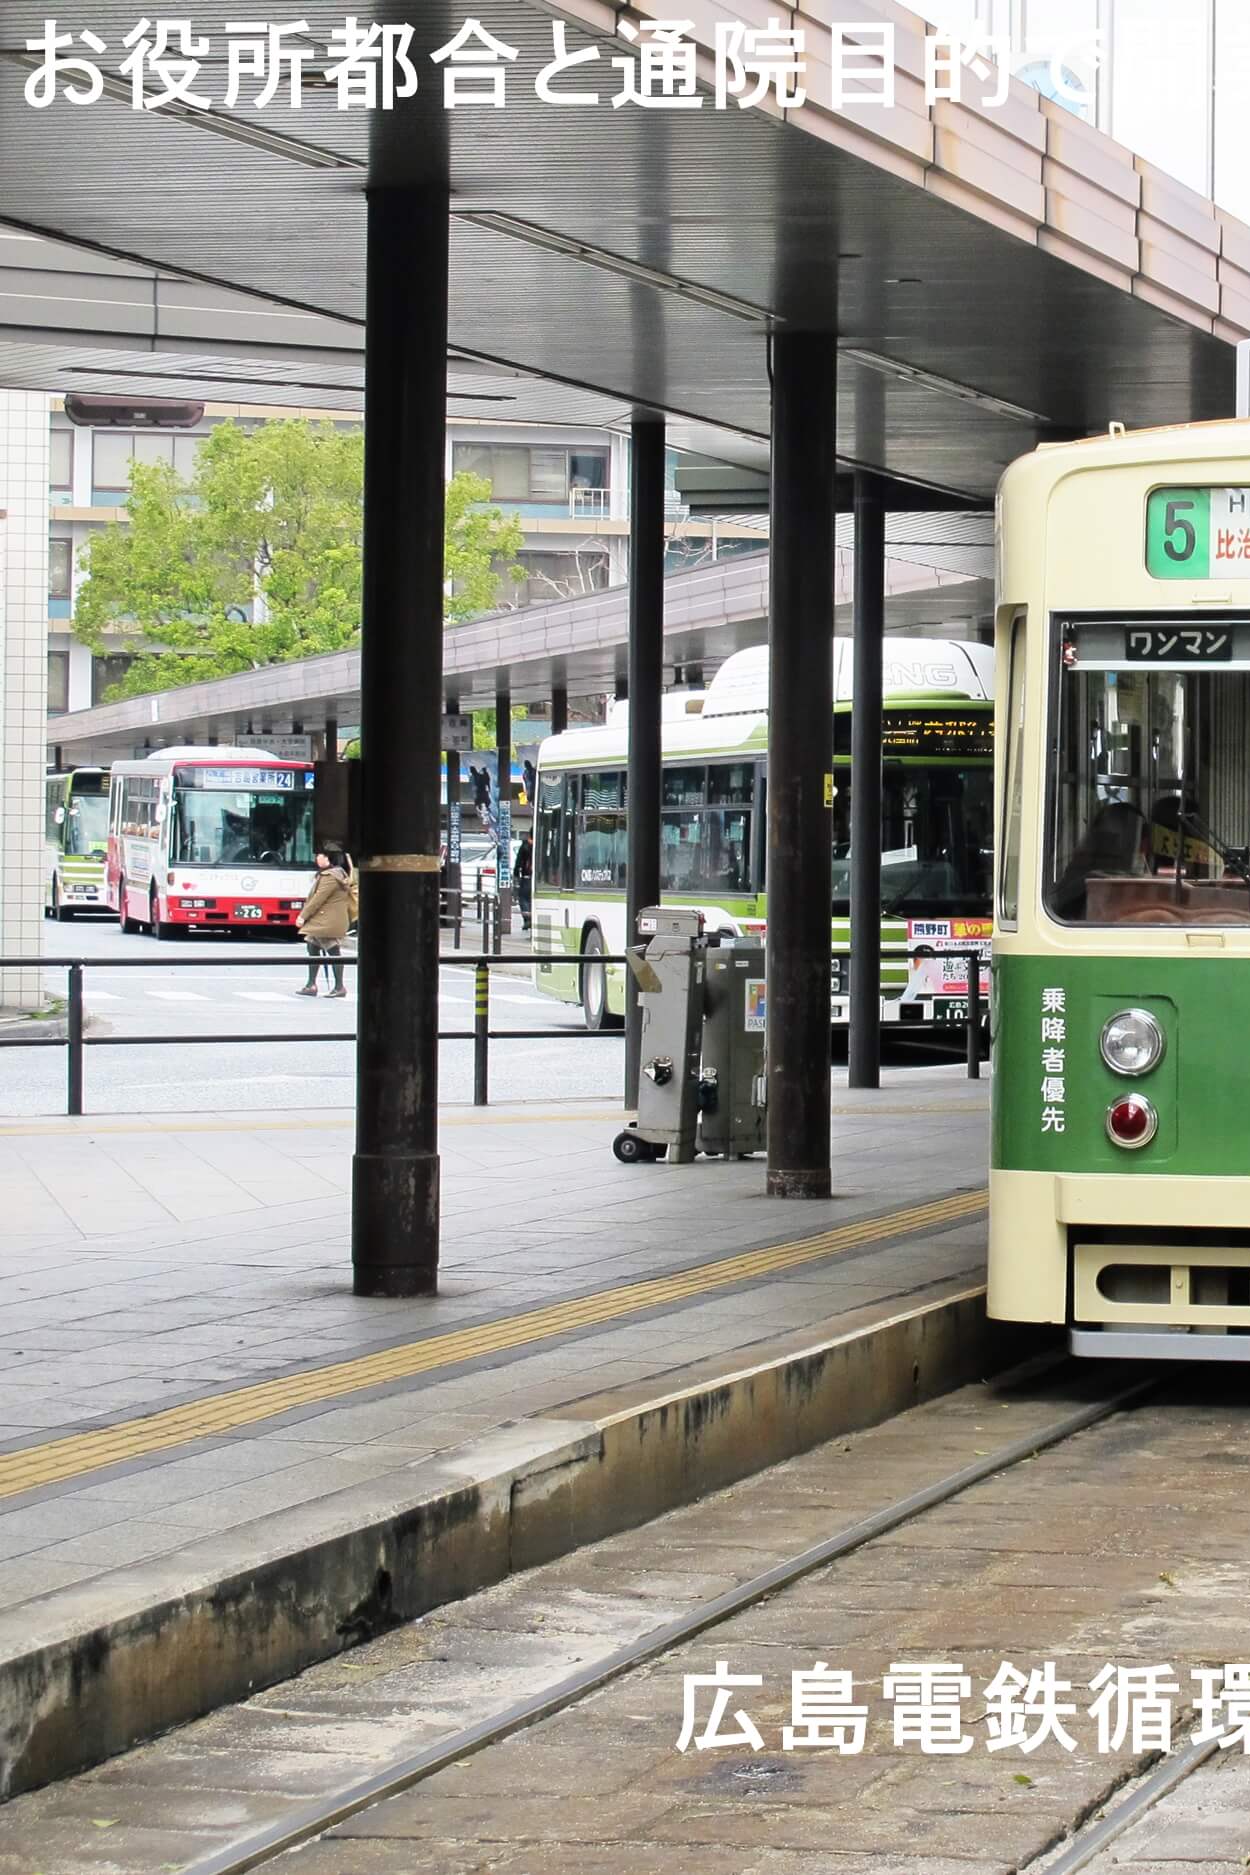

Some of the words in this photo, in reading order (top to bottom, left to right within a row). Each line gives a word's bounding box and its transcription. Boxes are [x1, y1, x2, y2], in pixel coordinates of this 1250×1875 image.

[1164, 501, 1196, 561] 5
[1130, 631, 1227, 655] ワンマン
[884, 662, 958, 687] NG
[278, 772, 292, 787] 24
[1041, 987, 1066, 1132] 乗降者優先
